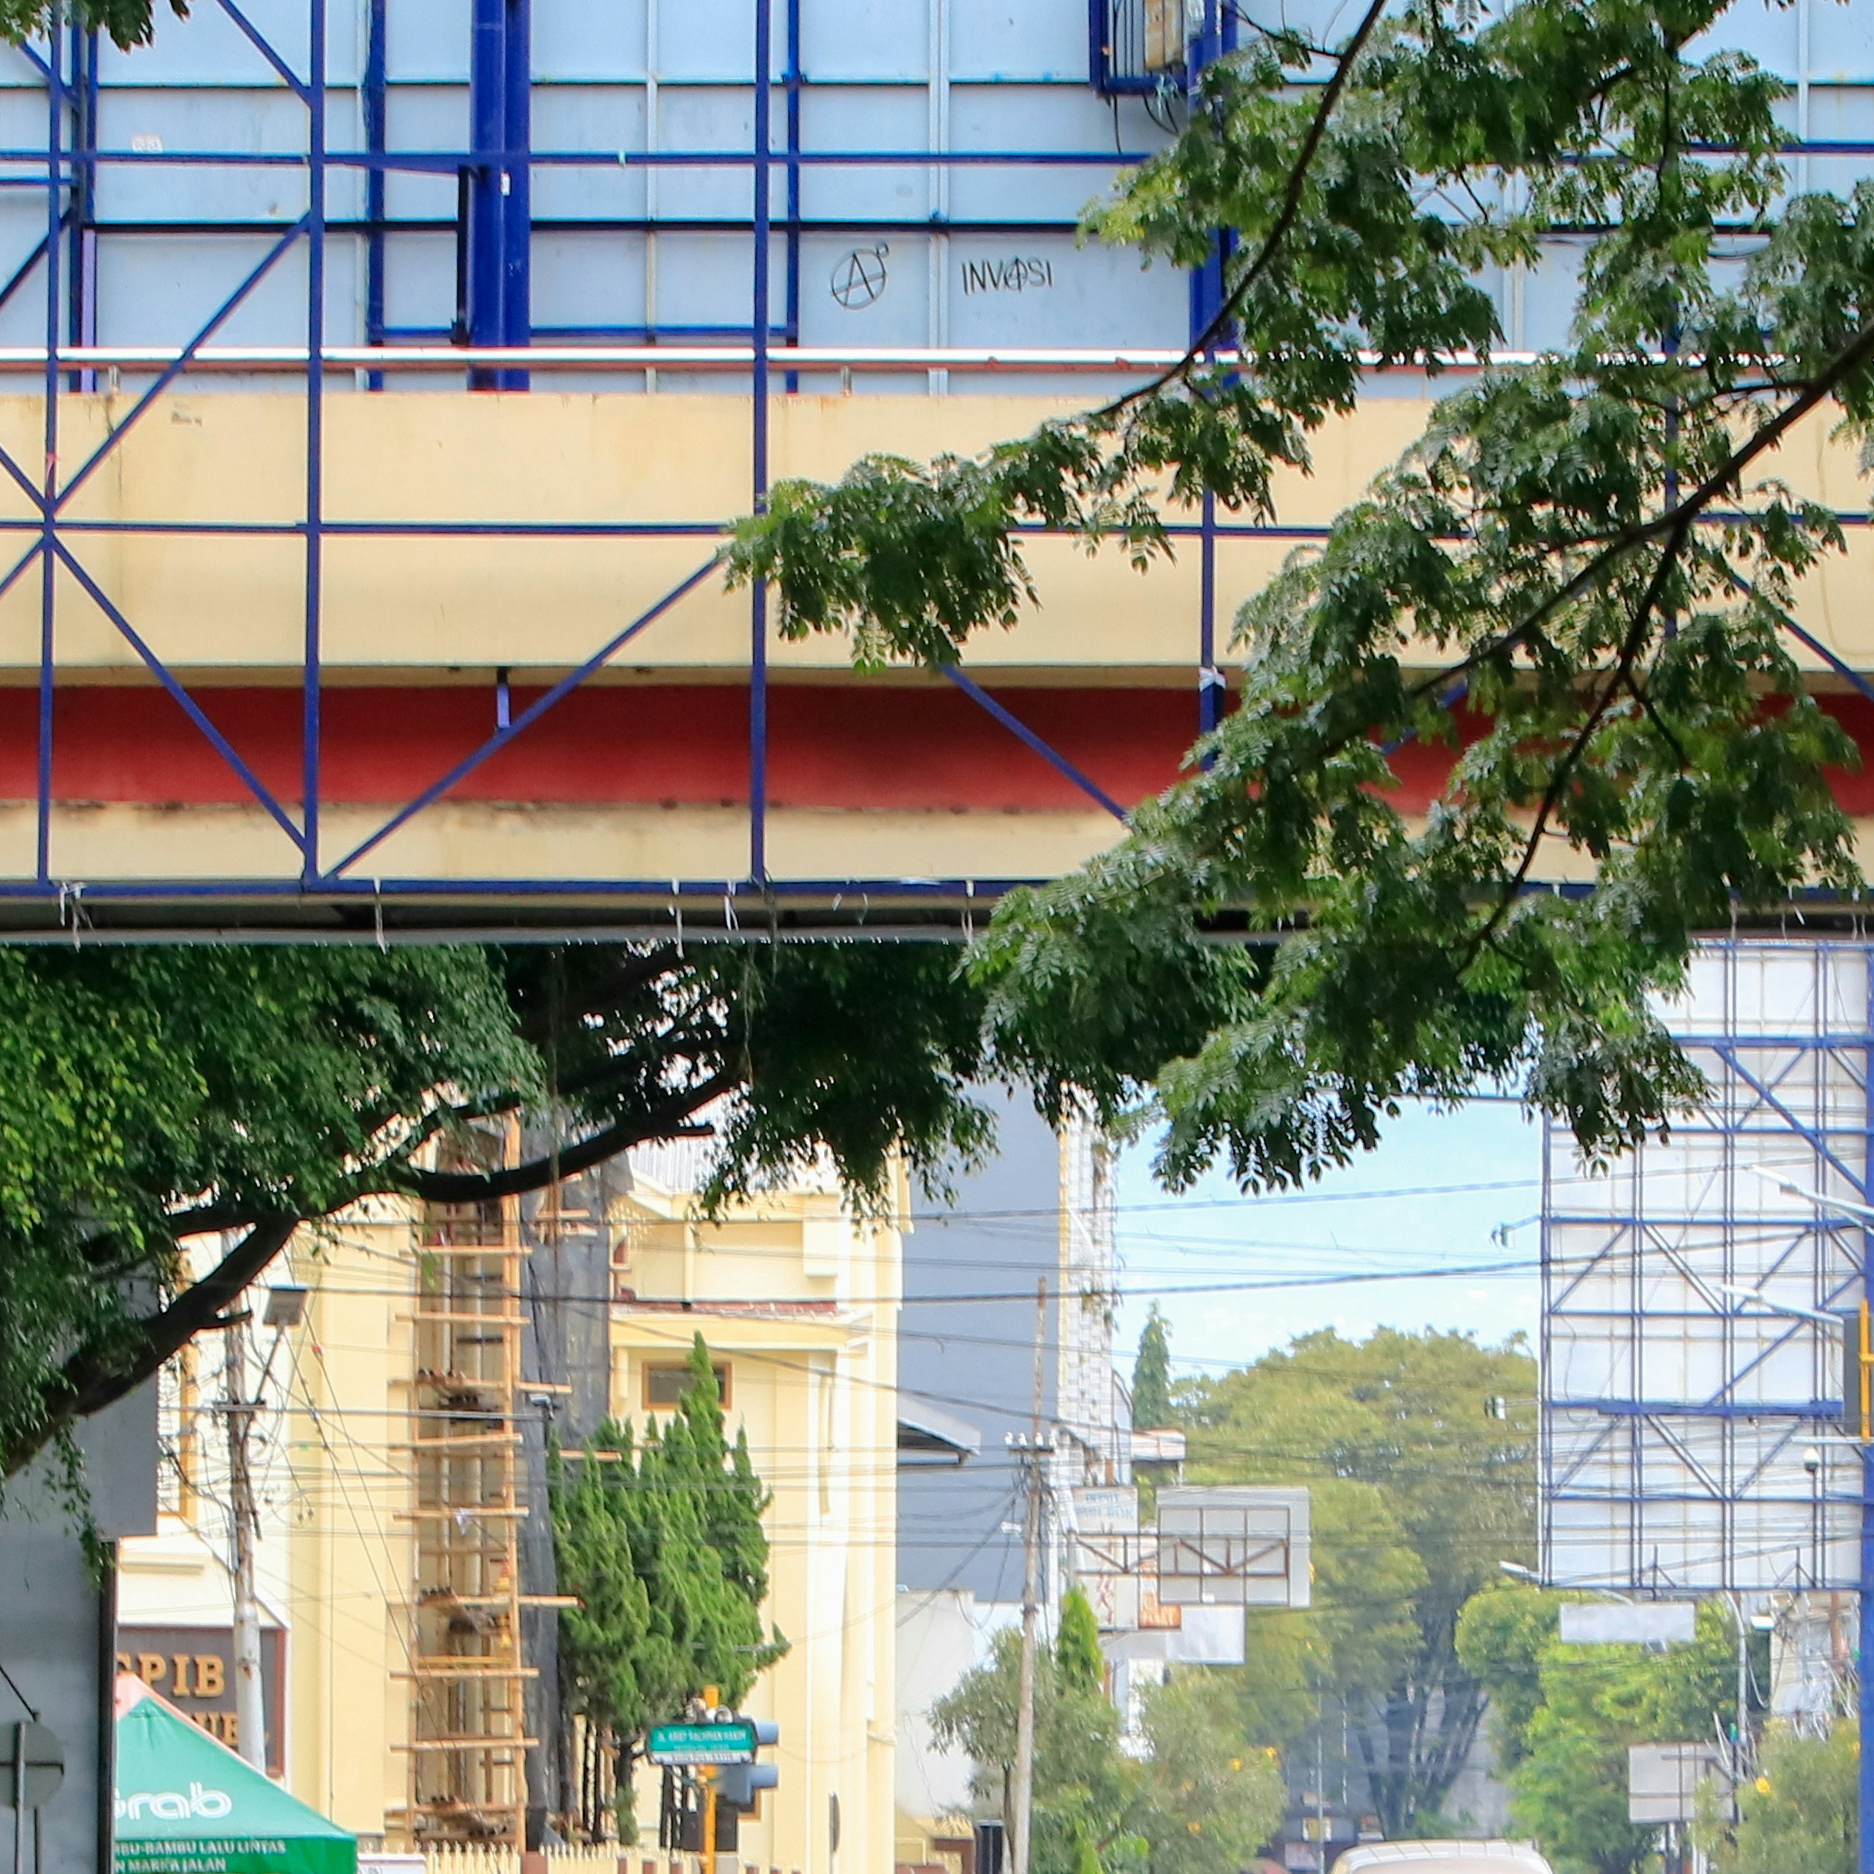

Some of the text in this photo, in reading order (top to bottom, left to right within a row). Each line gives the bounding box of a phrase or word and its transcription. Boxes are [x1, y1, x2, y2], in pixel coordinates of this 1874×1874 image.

[199, 1840, 235, 1855] LALU
[237, 1839, 287, 1855] LINTAS
[128, 1858, 181, 1873] MARKA
[182, 1857, 227, 1873] JALAN
